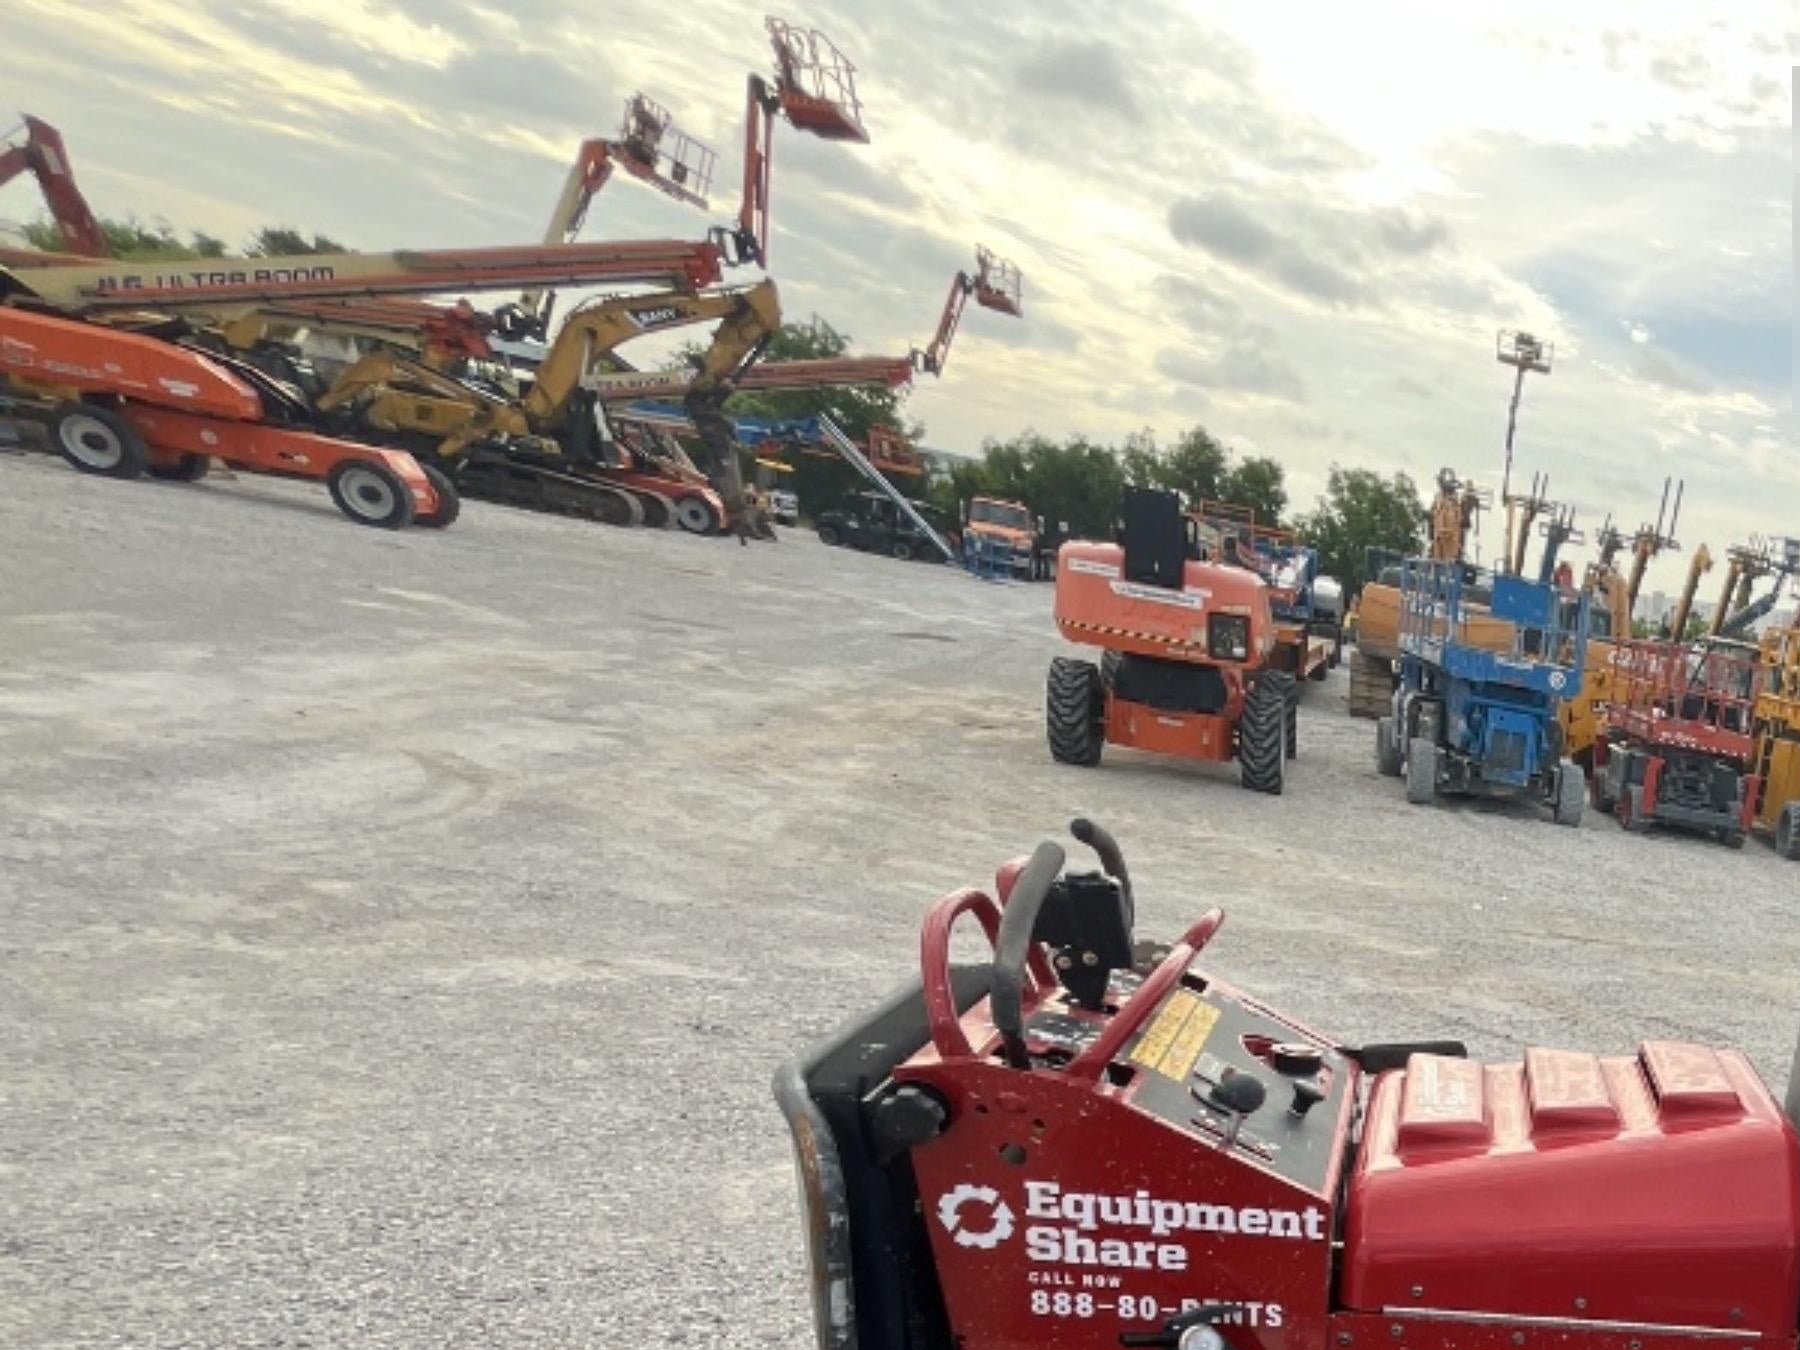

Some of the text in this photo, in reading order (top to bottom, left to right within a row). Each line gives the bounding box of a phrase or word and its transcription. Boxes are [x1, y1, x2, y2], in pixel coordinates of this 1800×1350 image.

[1023, 1181, 1327, 1241] Equipment
[1026, 1224, 1188, 1271] Share
[1028, 1271, 1123, 1288] CALL NOW
